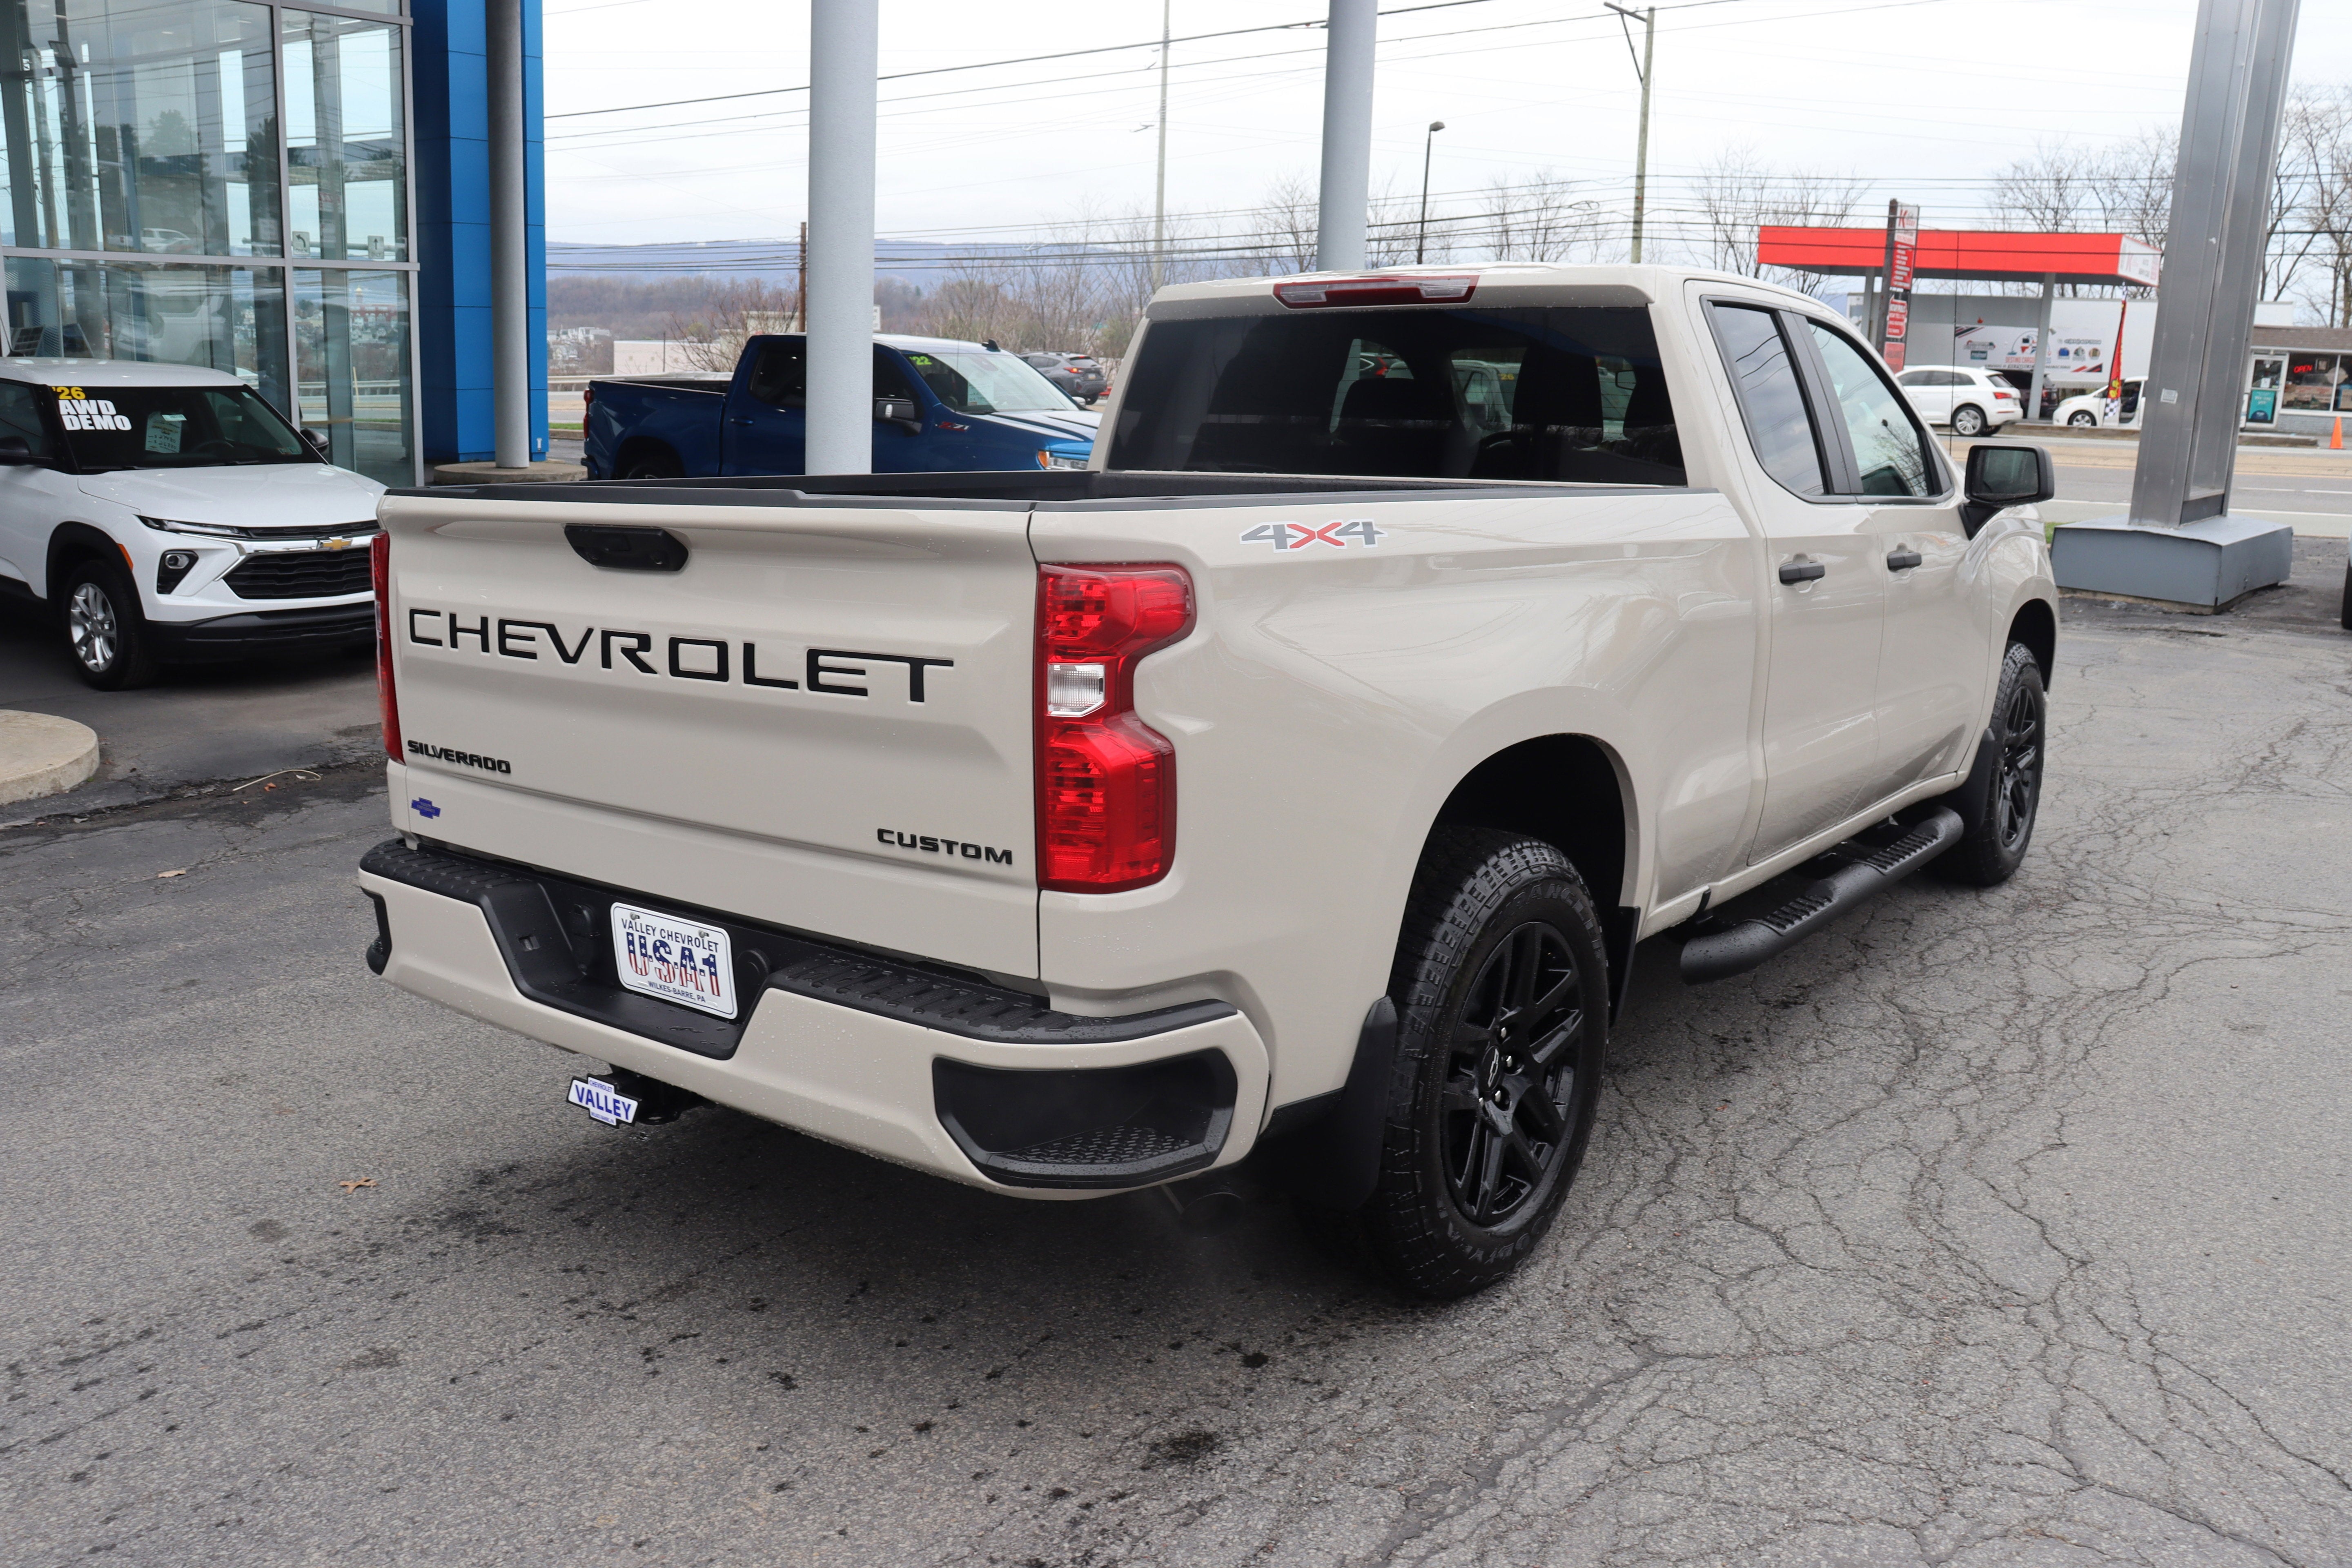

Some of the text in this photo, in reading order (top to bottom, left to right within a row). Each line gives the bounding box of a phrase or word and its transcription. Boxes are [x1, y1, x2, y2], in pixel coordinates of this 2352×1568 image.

[909, 356, 933, 365] '22
[2293, 364, 2313, 374] OPEN
[51, 386, 86, 400] '26
[58, 399, 117, 415] AWD
[61, 414, 132, 431] DEMO
[938, 421, 970, 432] Z71
[1241, 521, 1385, 550] 4X4
[409, 608, 954, 703] CHEVROLET
[407, 739, 512, 774] SILVERADO
[876, 828, 1013, 865] CUSTOM
[621, 918, 719, 953] VALLEY CHEVROLET
[648, 980, 706, 1003] WILKES-BARRE, PA
[589, 1080, 613, 1093] CHEVROLET
[575, 1084, 632, 1120] VALLEY
